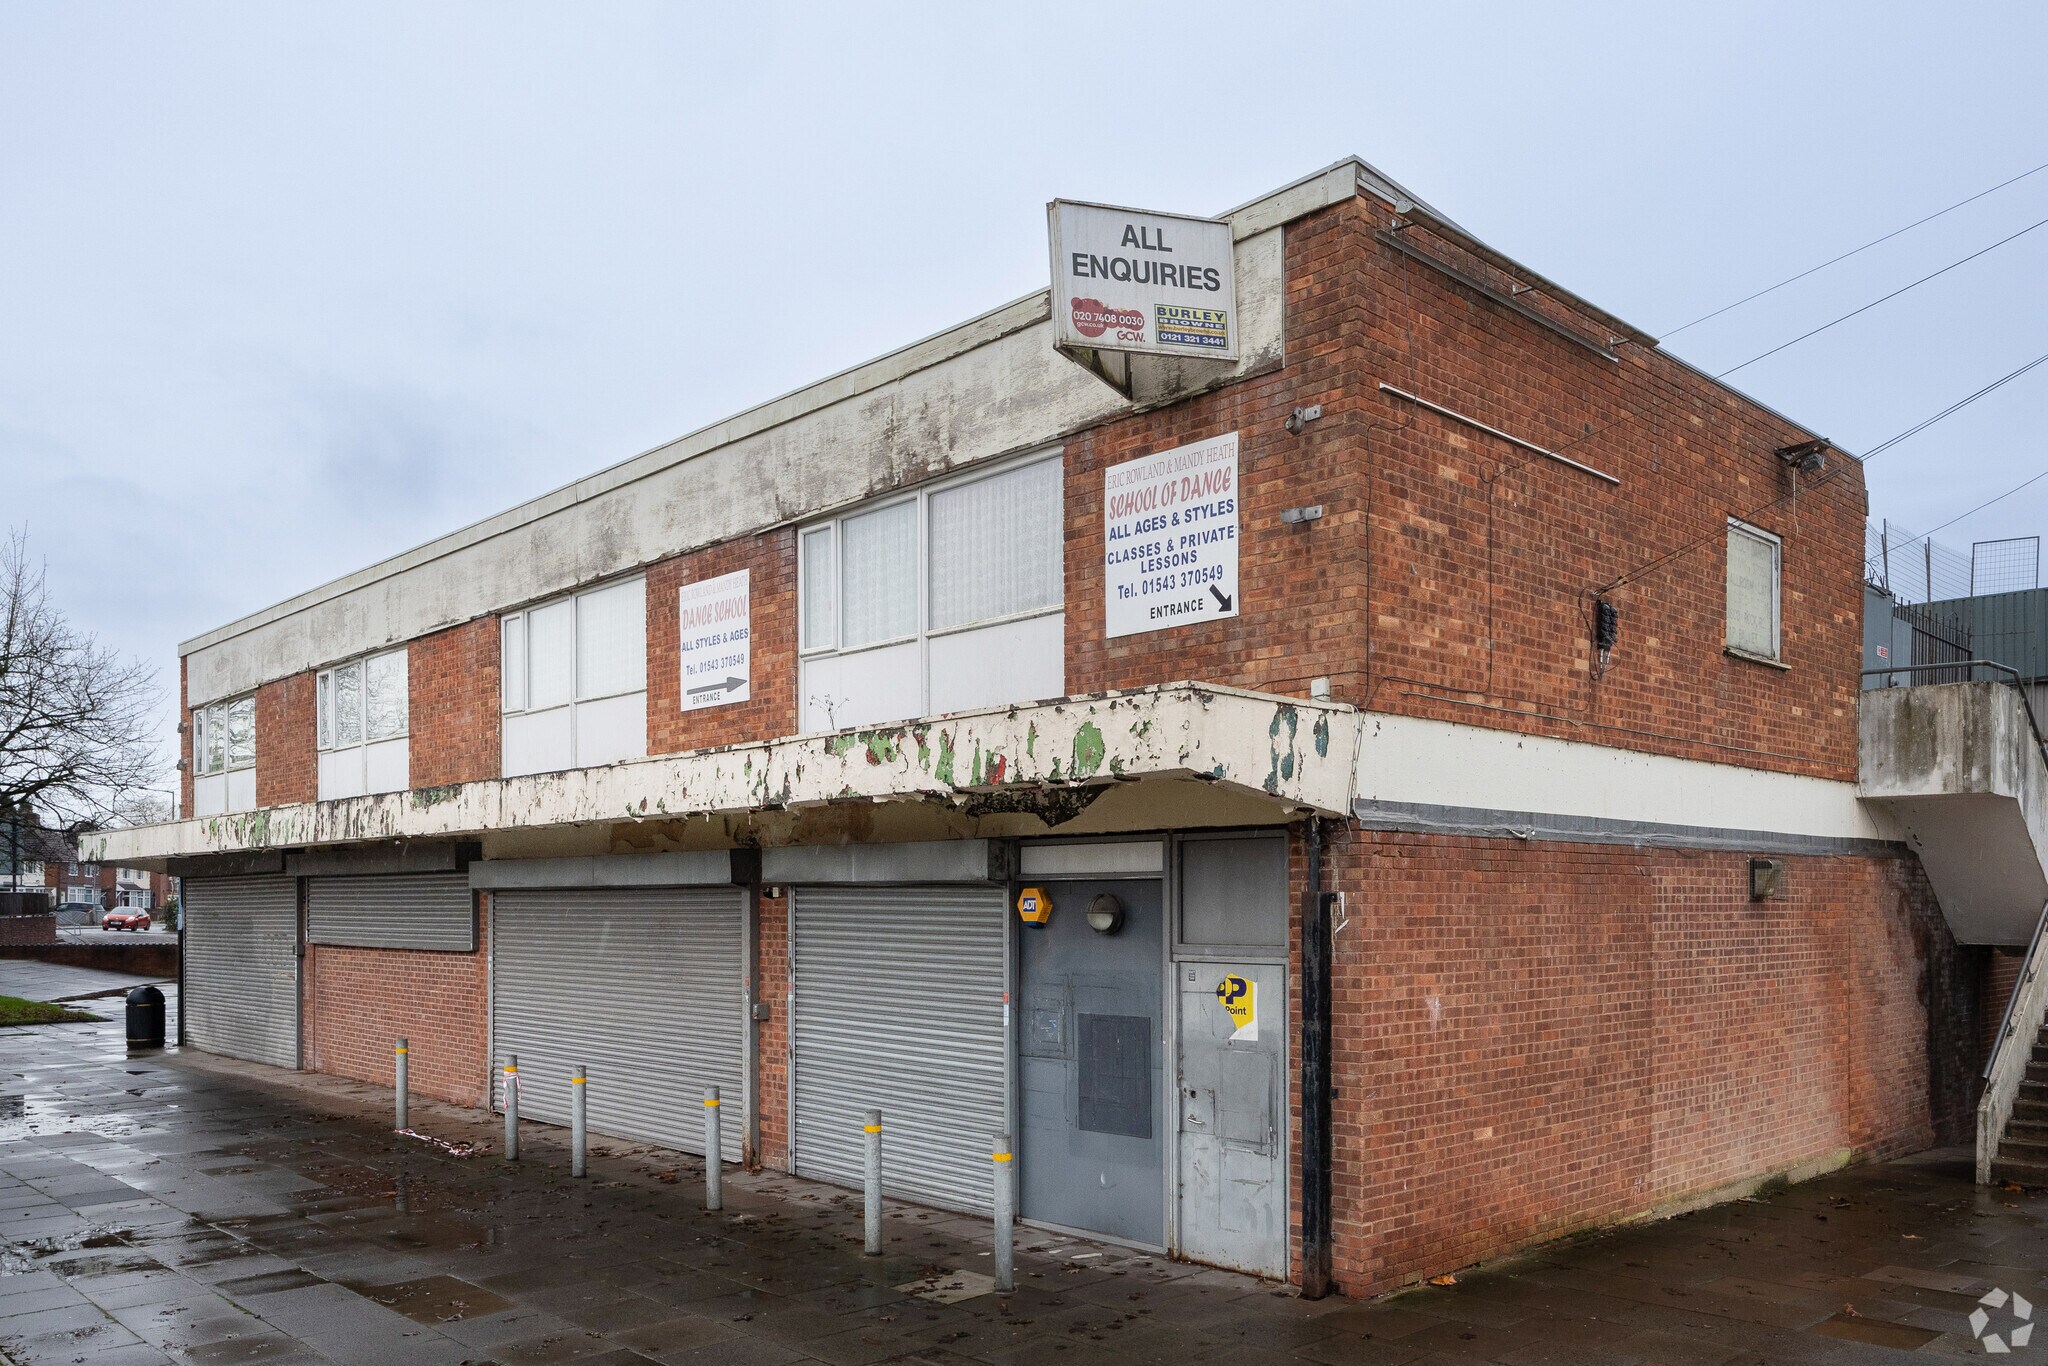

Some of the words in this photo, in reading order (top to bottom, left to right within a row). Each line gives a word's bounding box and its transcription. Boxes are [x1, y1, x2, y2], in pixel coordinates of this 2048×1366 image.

[1121, 224, 1172, 252] ALL
[1072, 252, 1220, 292] ENQUIRIES
[1073, 310, 1092, 320] 020
[1094, 313, 1116, 323] 7408
[1119, 316, 1144, 326] 0030
[1157, 306, 1224, 322] BURLEY
[1159, 318, 1224, 329] BROWNE
[1161, 333, 1181, 341] 0121
[1184, 335, 1200, 343] 321
[1202, 336, 1224, 345] 3441
[1108, 472, 1124, 490] ERIC
[1126, 464, 1166, 484] ROWLAND
[1166, 462, 1173, 474] &
[1174, 450, 1205, 473] MANDY
[1206, 442, 1235, 463] HEATH
[1109, 484, 1158, 520] SCHOOL
[1161, 480, 1177, 506] OF
[1180, 466, 1232, 502] DANCE
[1109, 524, 1131, 541] ALL
[1134, 515, 1167, 535] AGES
[1172, 512, 1180, 526] &
[1184, 498, 1234, 523] STYLES
[1108, 542, 1160, 564] CLASSES
[1167, 537, 1174, 552] &
[1180, 525, 1234, 550] PRIVATE
[1141, 550, 1198, 574] LESSONS
[1118, 584, 1138, 600] Tel.
[1142, 574, 1176, 595] 01543
[1180, 564, 1223, 587] 370549
[683, 603, 712, 630] DANCE
[714, 594, 746, 623] SCHOOL
[1150, 598, 1204, 619] ENTRANCE
[682, 640, 694, 652] ALL
[696, 634, 720, 650] STYLES
[722, 632, 728, 644] &
[730, 628, 748, 642] AGES
[686, 664, 698, 676] Tel.
[700, 659, 718, 674] 01543
[720, 653, 744, 668] 370549
[692, 692, 720, 704] ENTRANCE
[1023, 900, 1036, 910] ADT
